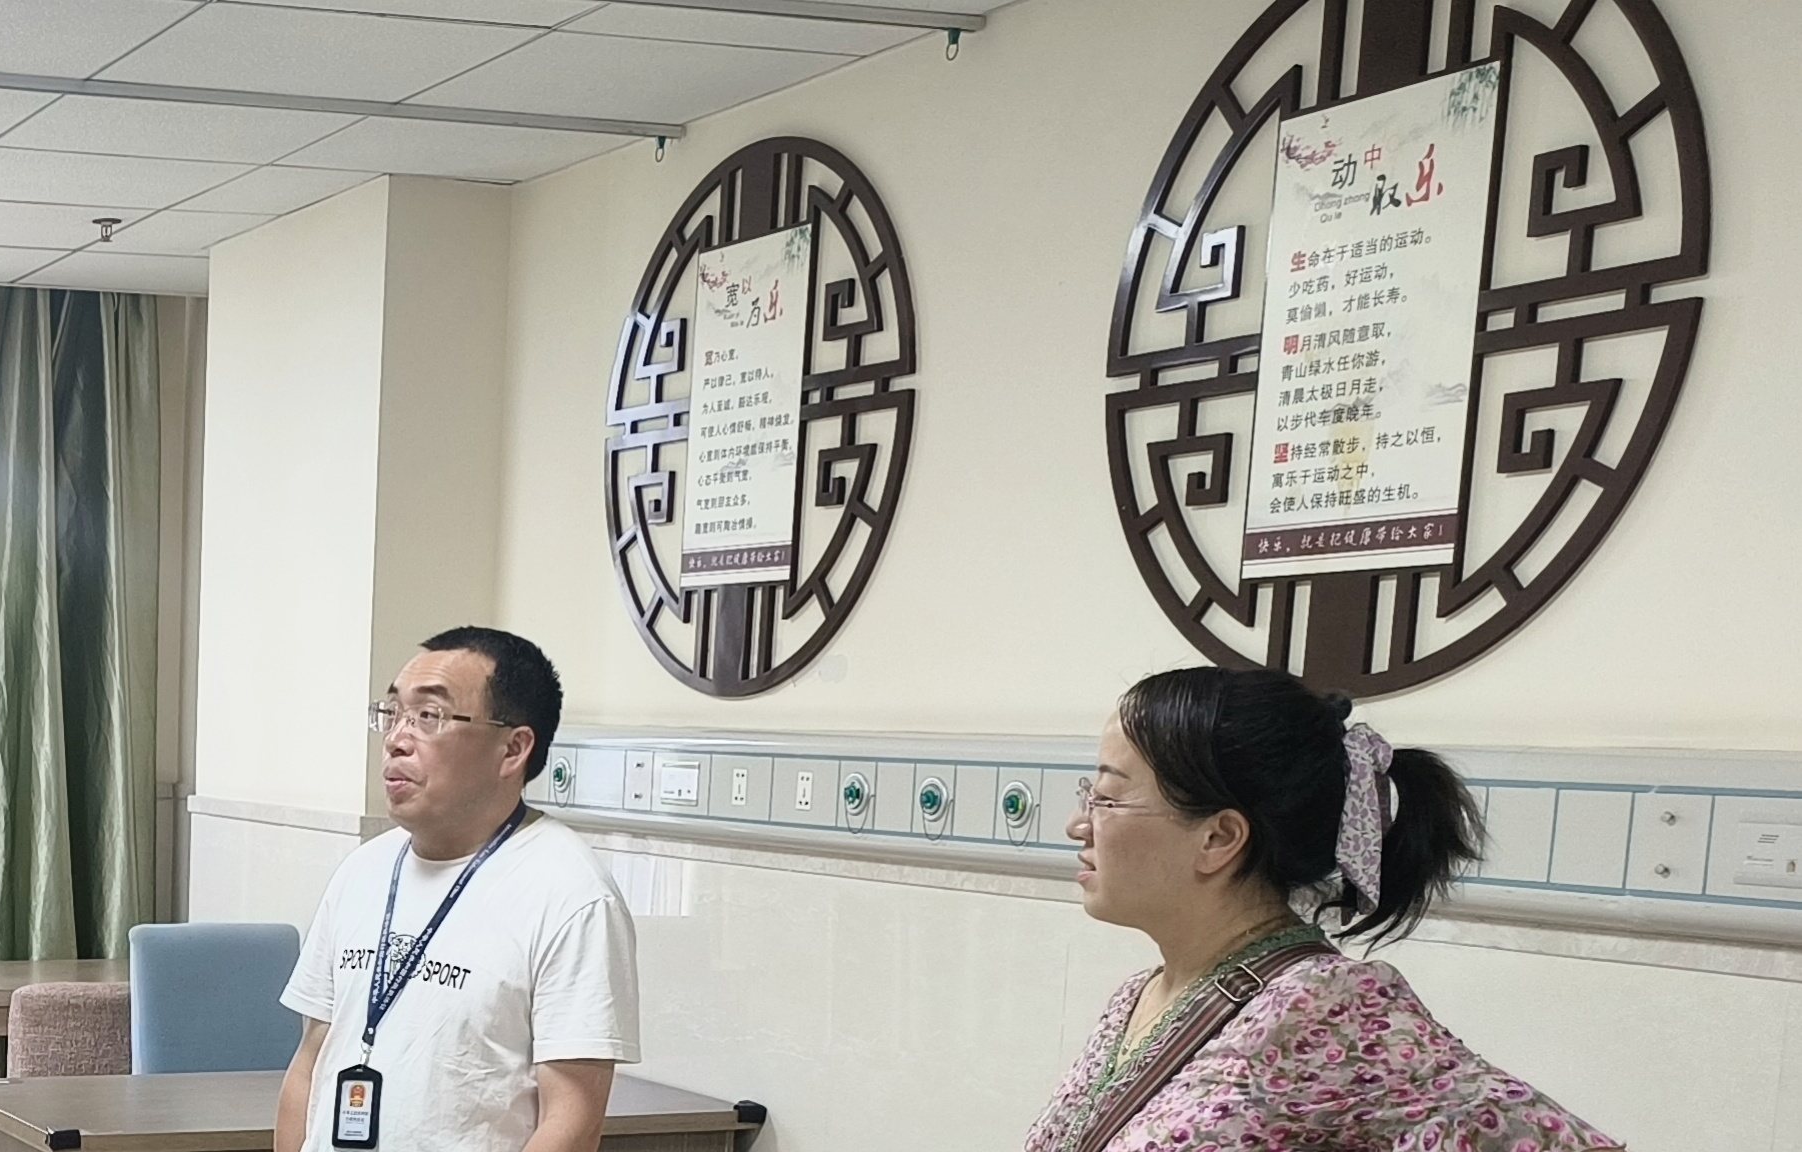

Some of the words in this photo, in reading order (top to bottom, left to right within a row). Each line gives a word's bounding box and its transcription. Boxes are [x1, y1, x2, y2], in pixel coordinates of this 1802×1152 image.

[1290, 228, 1432, 272] 生命在于适当的运动。
[1283, 322, 1391, 355] 明月清风随意取，
[1281, 350, 1386, 382] 青山绿水任你游，
[1278, 377, 1384, 407] 清晨太极日月走，
[1270, 484, 1419, 514] 会使人保持旺盛的生机。
[422, 960, 471, 990] SPORT
